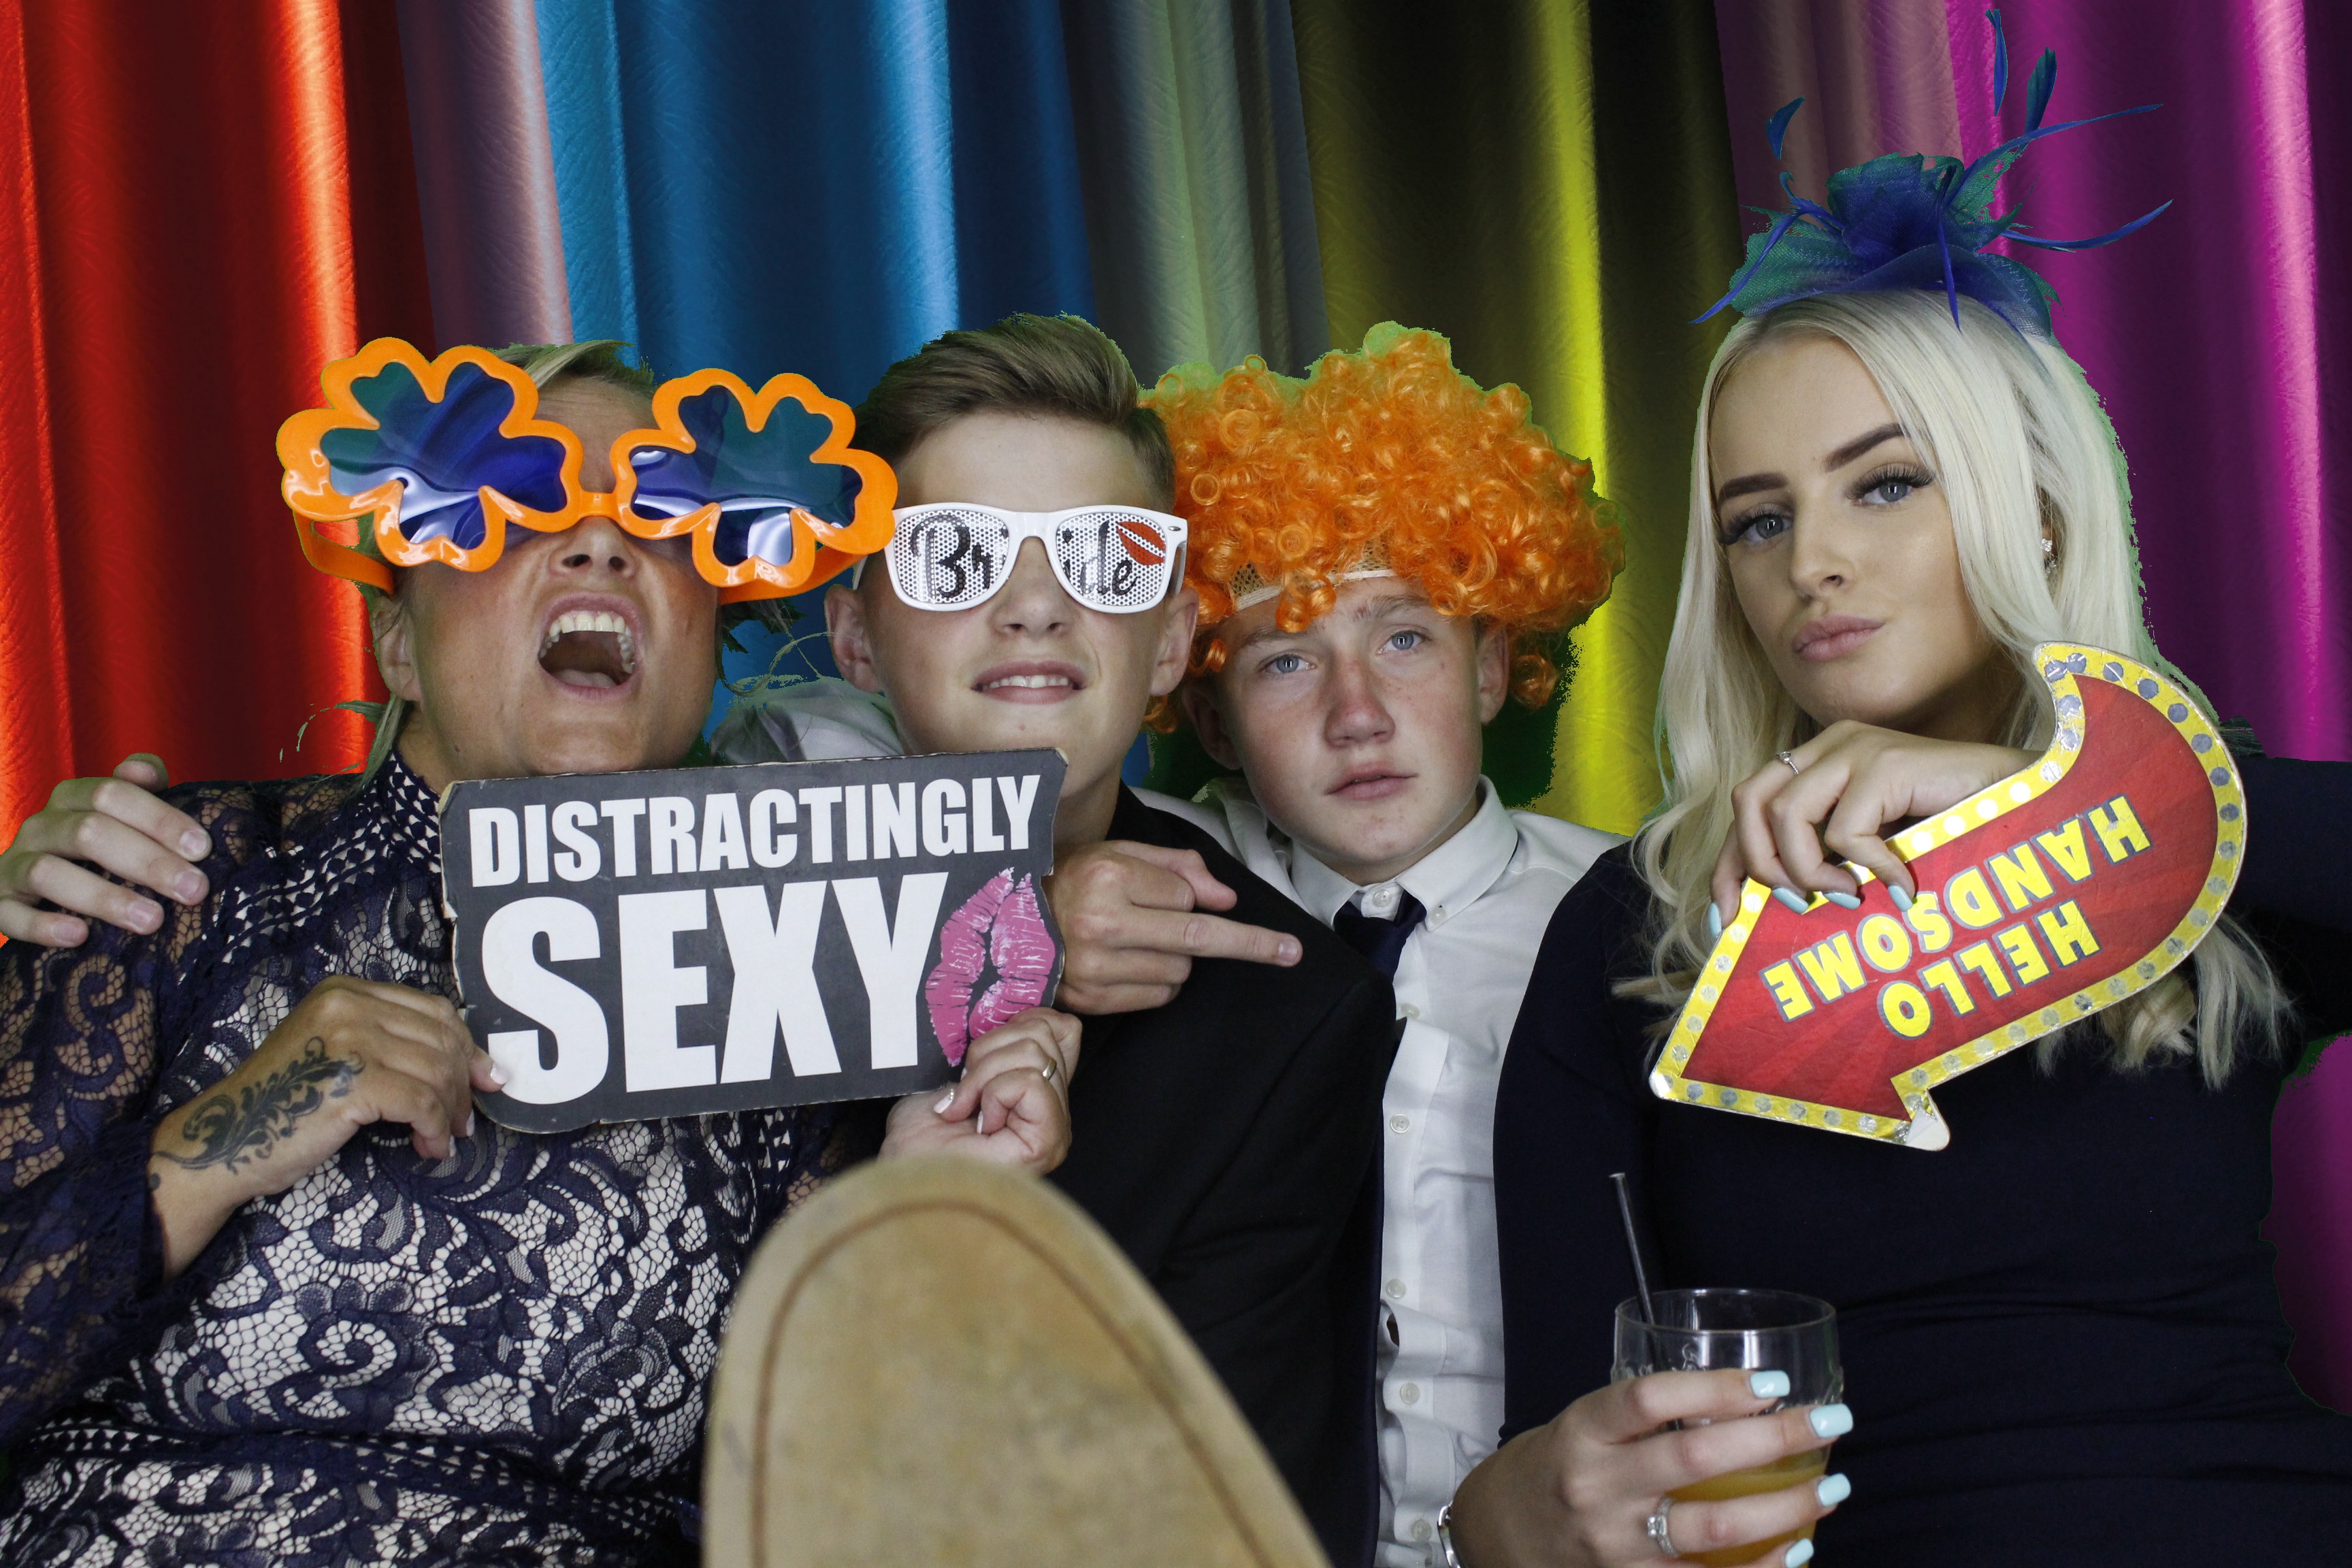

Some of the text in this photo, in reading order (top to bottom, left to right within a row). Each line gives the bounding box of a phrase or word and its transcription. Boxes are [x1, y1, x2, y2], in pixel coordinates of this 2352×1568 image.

[468, 774, 1041, 887] DISTRACTINGLY
[1761, 794, 2151, 1021] HANDSOME
[481, 871, 949, 1105] SEXY
[1880, 898, 2100, 1038] HELLO
